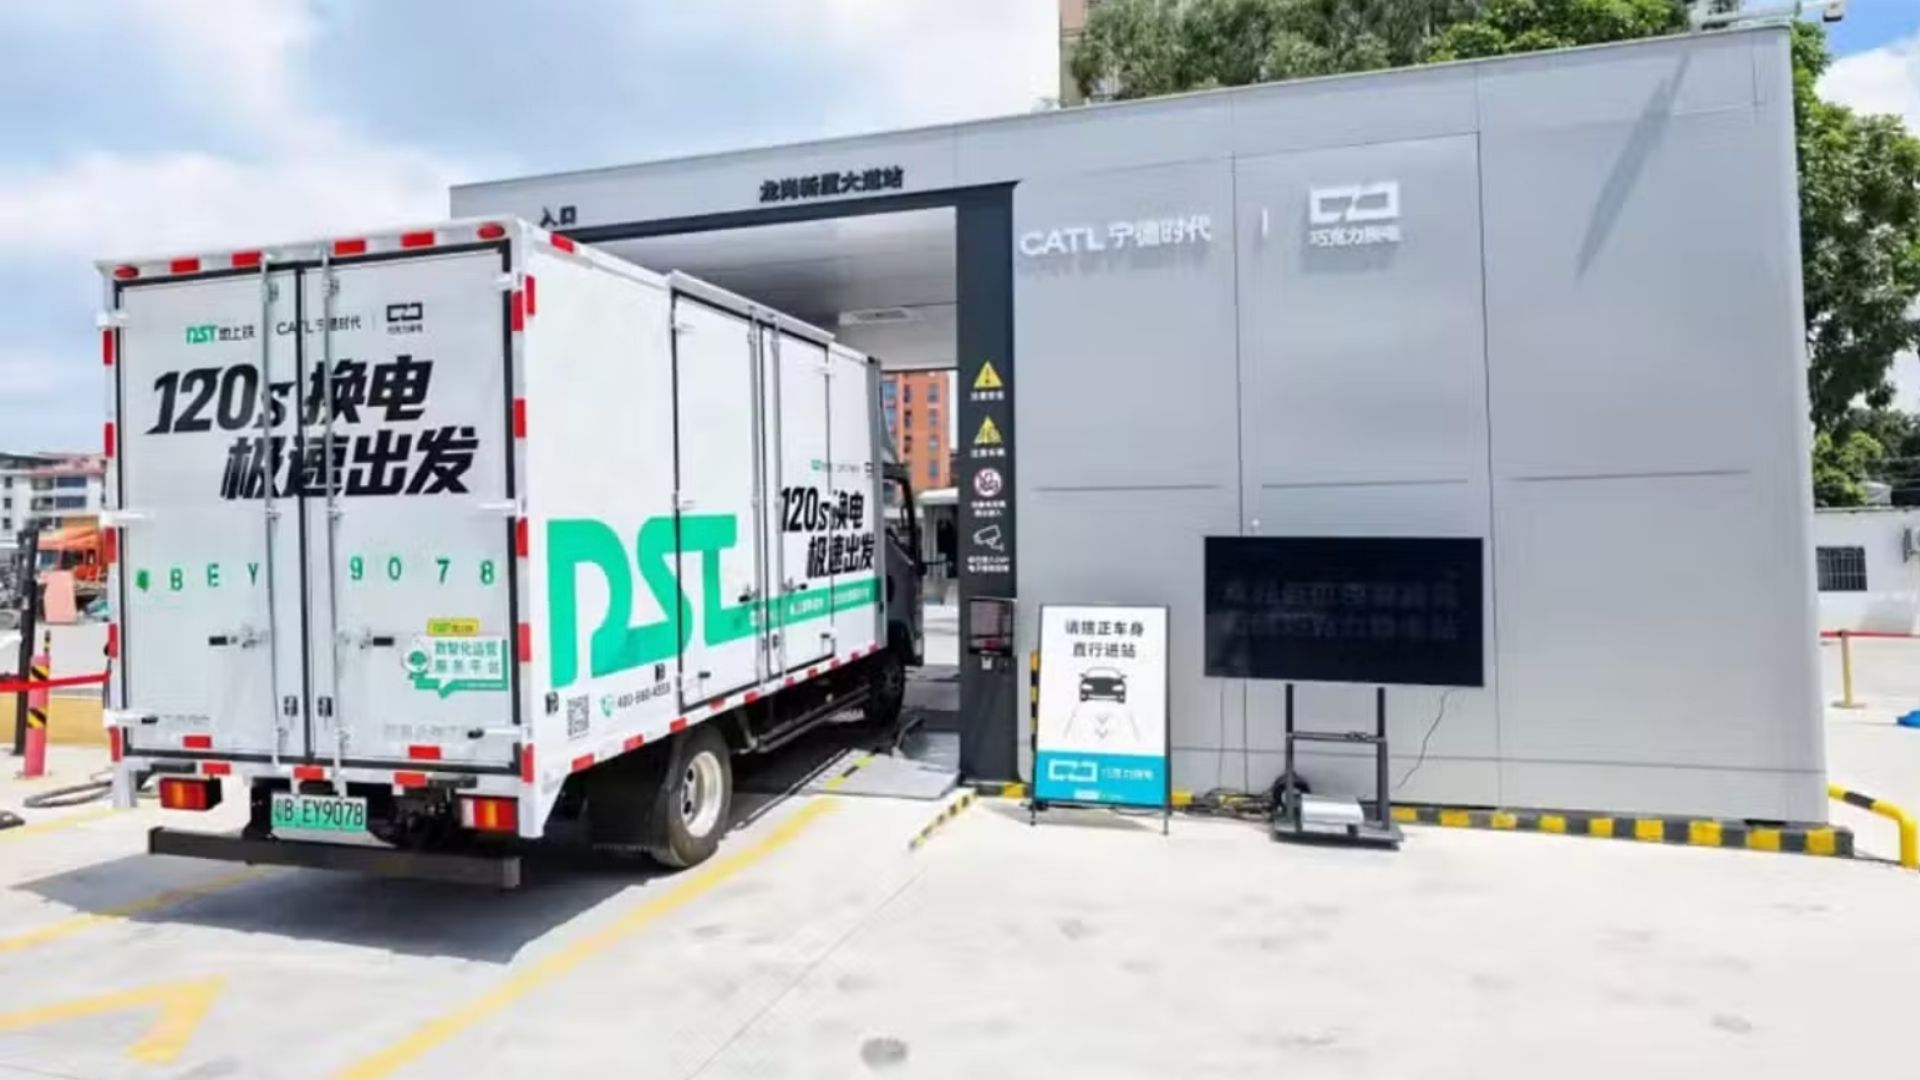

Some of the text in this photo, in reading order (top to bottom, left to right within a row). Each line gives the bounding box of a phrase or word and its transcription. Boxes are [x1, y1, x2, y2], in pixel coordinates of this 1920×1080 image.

[539, 205, 577, 229] 入口
[1019, 227, 1106, 256] CATL
[276, 320, 315, 336] CAL
[220, 426, 479, 500] 极速出发
[547, 513, 737, 690] DST
